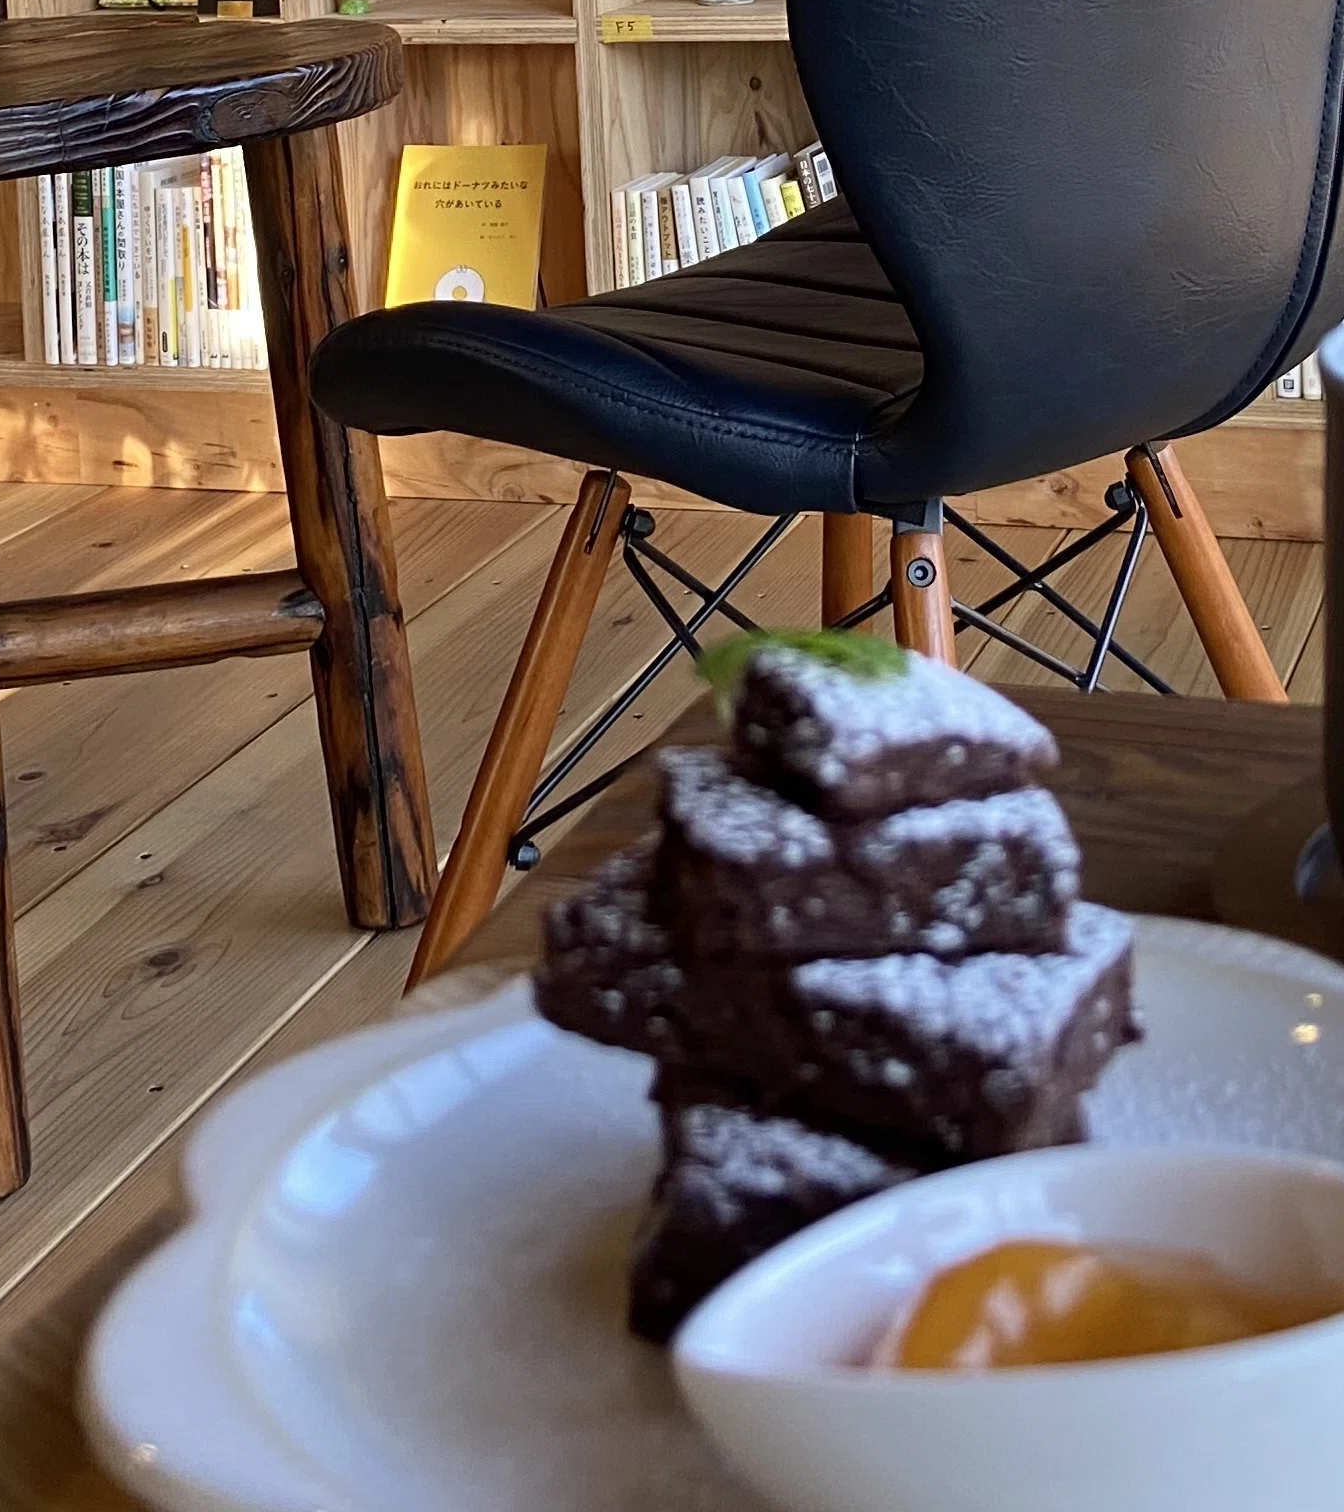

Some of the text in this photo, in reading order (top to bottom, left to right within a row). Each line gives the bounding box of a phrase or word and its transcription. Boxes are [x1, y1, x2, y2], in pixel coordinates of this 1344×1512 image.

[413, 177, 529, 193] おれにはドーナツみたいな
[435, 197, 503, 211] 穴があいている
[75, 222, 91, 276] その本は
